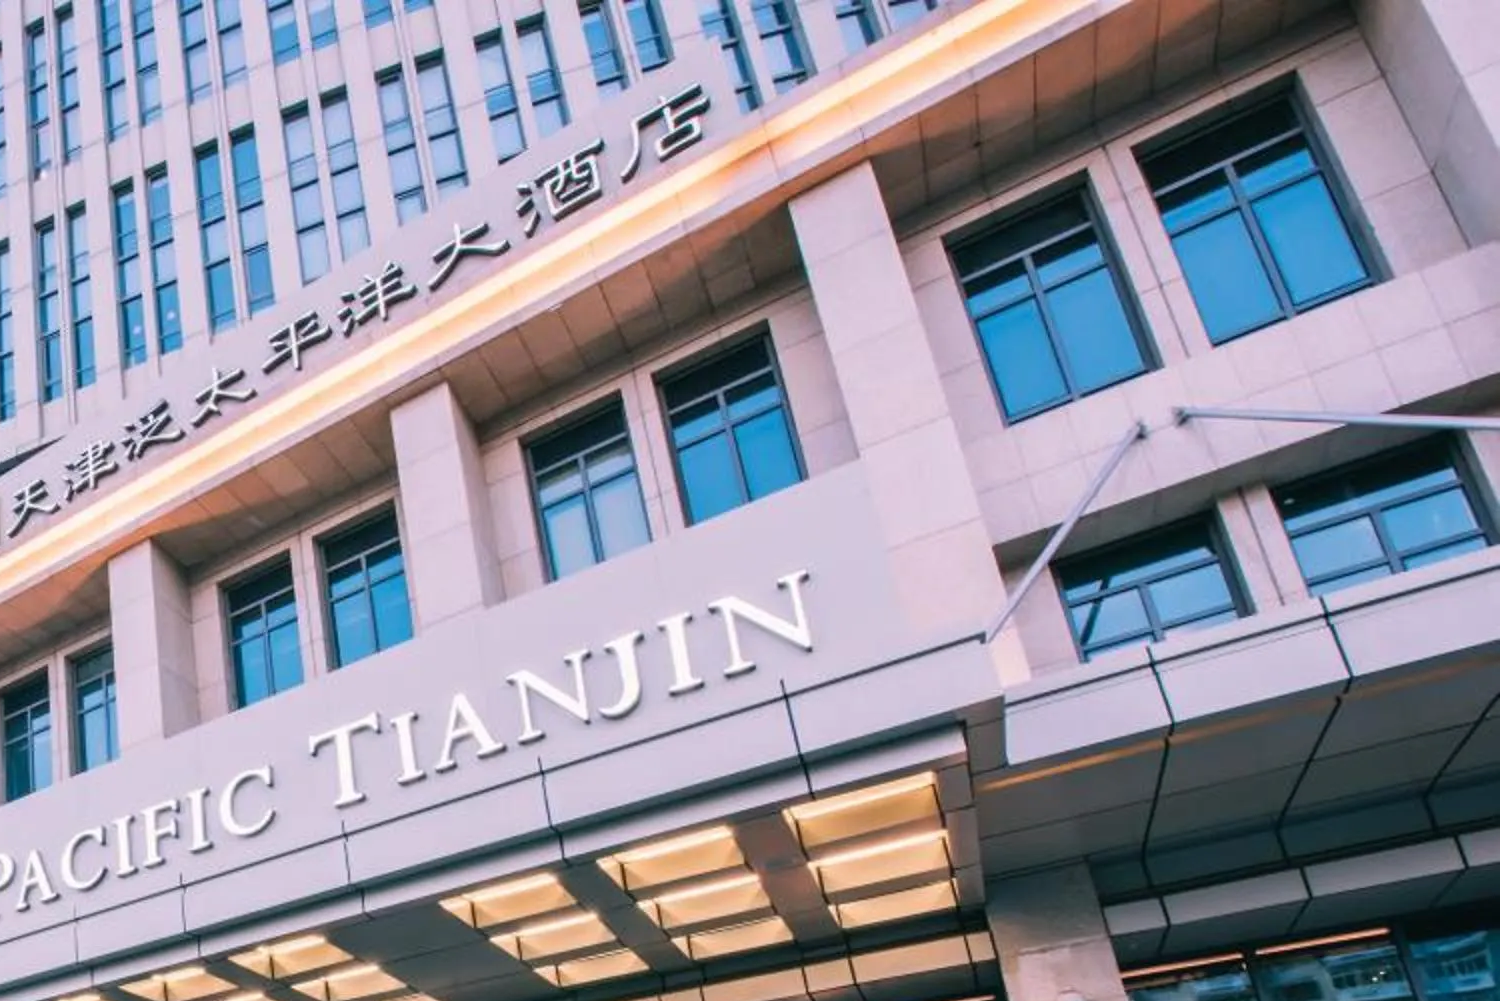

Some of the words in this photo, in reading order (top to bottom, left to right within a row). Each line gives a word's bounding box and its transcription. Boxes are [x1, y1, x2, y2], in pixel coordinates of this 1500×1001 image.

[6, 82, 711, 537] 天津泛太平洋大酒店
[309, 571, 812, 808] TIANJIN
